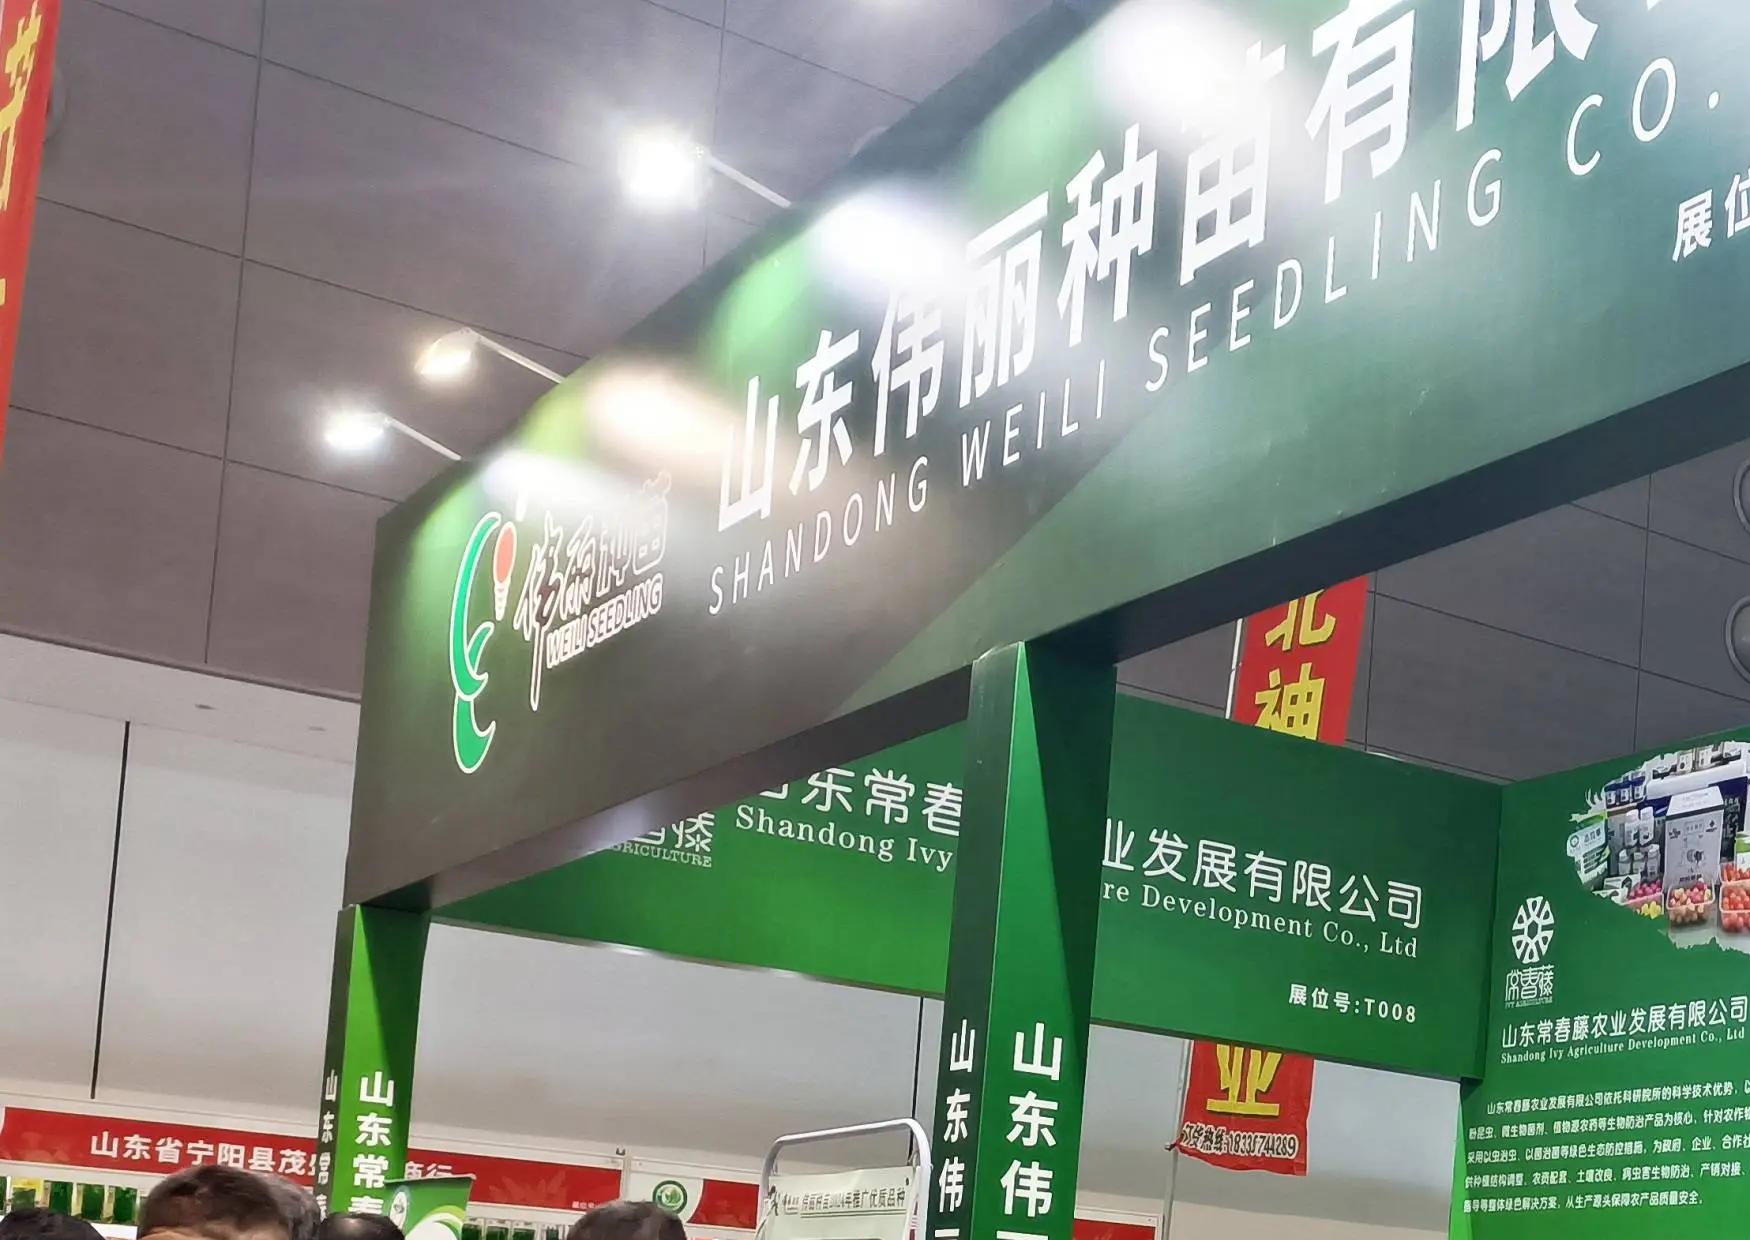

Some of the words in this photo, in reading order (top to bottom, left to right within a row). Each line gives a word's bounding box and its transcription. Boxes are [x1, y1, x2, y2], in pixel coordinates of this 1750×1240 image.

[708, 456, 929, 616] SHANDONG
[961, 359, 1106, 486] WEILI
[1146, 149, 1502, 392] SEEDLING
[760, 767, 963, 837] 东常春
[736, 804, 893, 863] Shandong
[906, 838, 954, 873] Ivy
[1102, 817, 1422, 929] 业发展有限公司
[1103, 880, 1130, 901] re
[1142, 884, 1313, 938] Development
[1323, 921, 1369, 953] Co.,
[1380, 931, 1418, 958] Ltd
[1288, 983, 1417, 1023] 展位号:T008
[1501, 996, 1748, 1049] 山东常春藤农业发展有限公司
[1500, 1049, 1546, 1065] Shandong
[1549, 1045, 1565, 1060] Ivy
[1567, 1040, 1624, 1058] Agriculture
[1628, 1033, 1697, 1051] Development
[1727, 1026, 1746, 1041] Ltd
[90, 1131, 318, 1190] 山东省宁阳县茂
